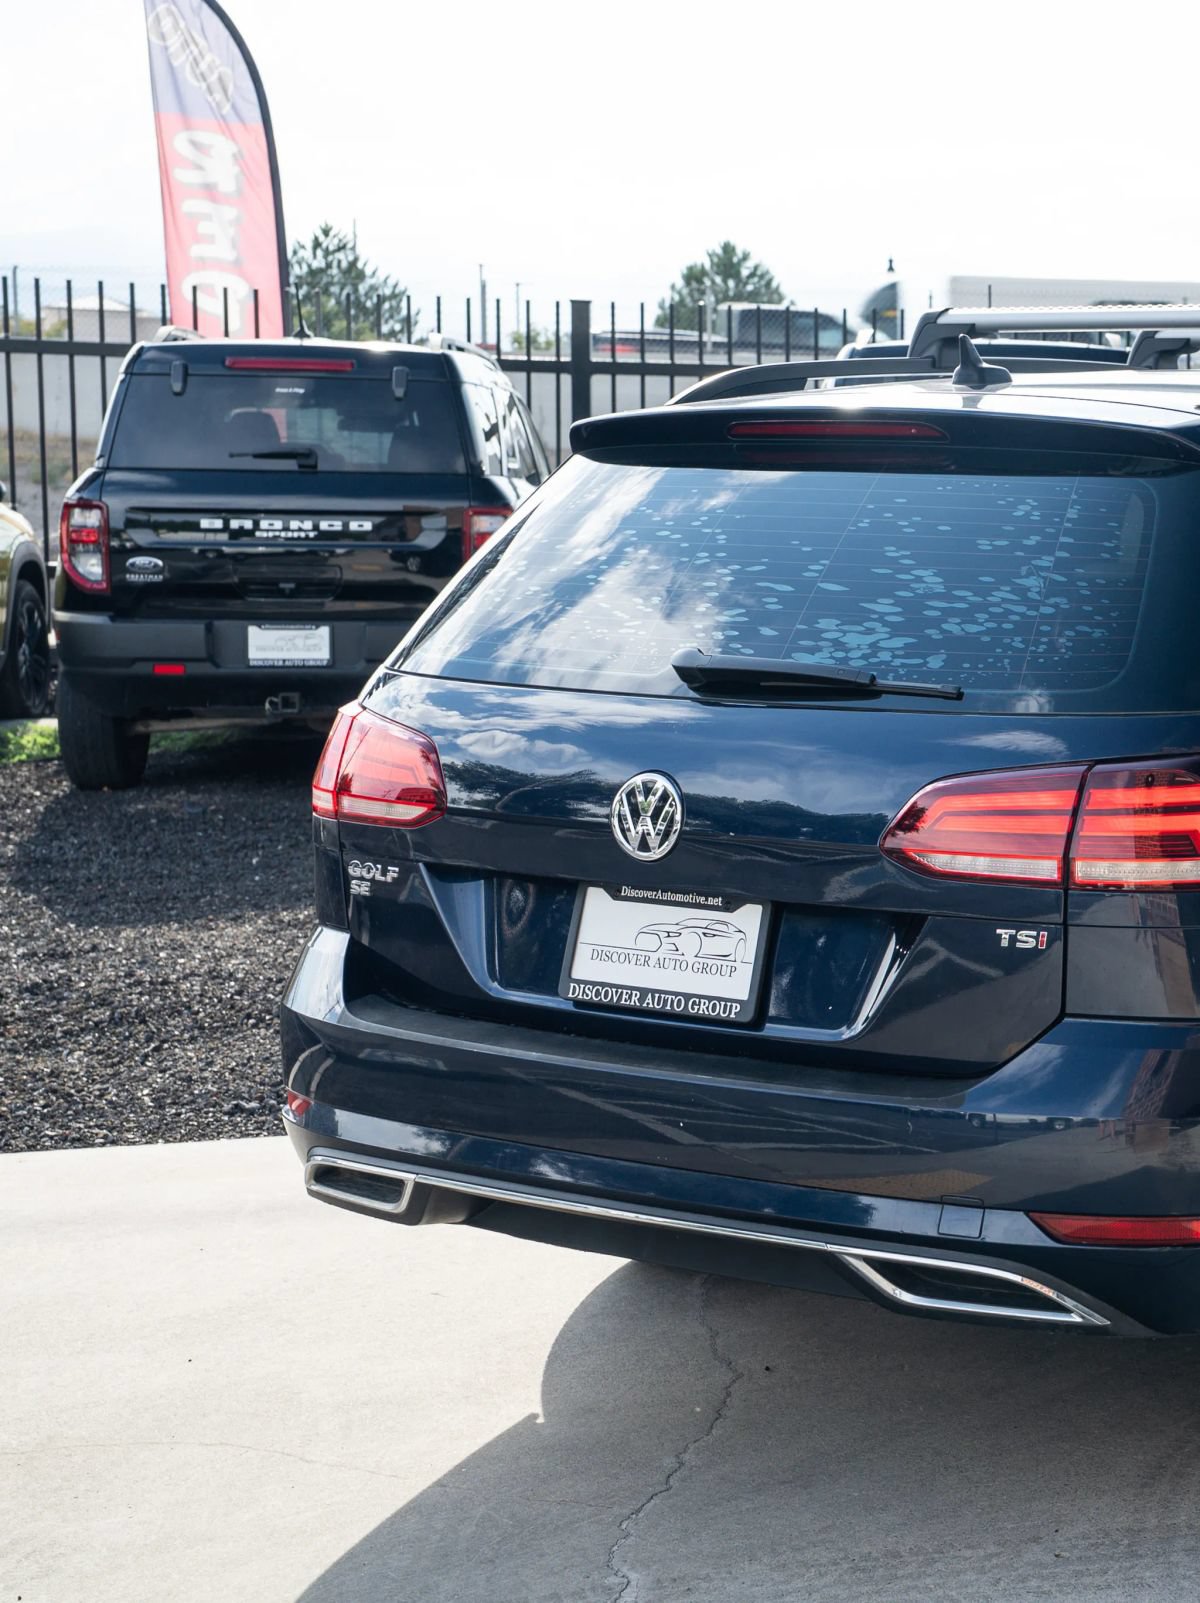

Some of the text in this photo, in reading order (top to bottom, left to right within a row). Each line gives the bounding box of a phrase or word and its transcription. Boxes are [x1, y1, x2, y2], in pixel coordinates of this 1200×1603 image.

[200, 518, 372, 531] BRONCO
[255, 530, 318, 538] SPORT
[348, 860, 399, 882] GOLF
[350, 880, 371, 896] SE
[621, 885, 723, 906] DiscoverAutomotive.net
[590, 948, 737, 978] DISCOVER AUTO GROUP
[568, 983, 741, 1018] DISCOVER AUTO GROUP
